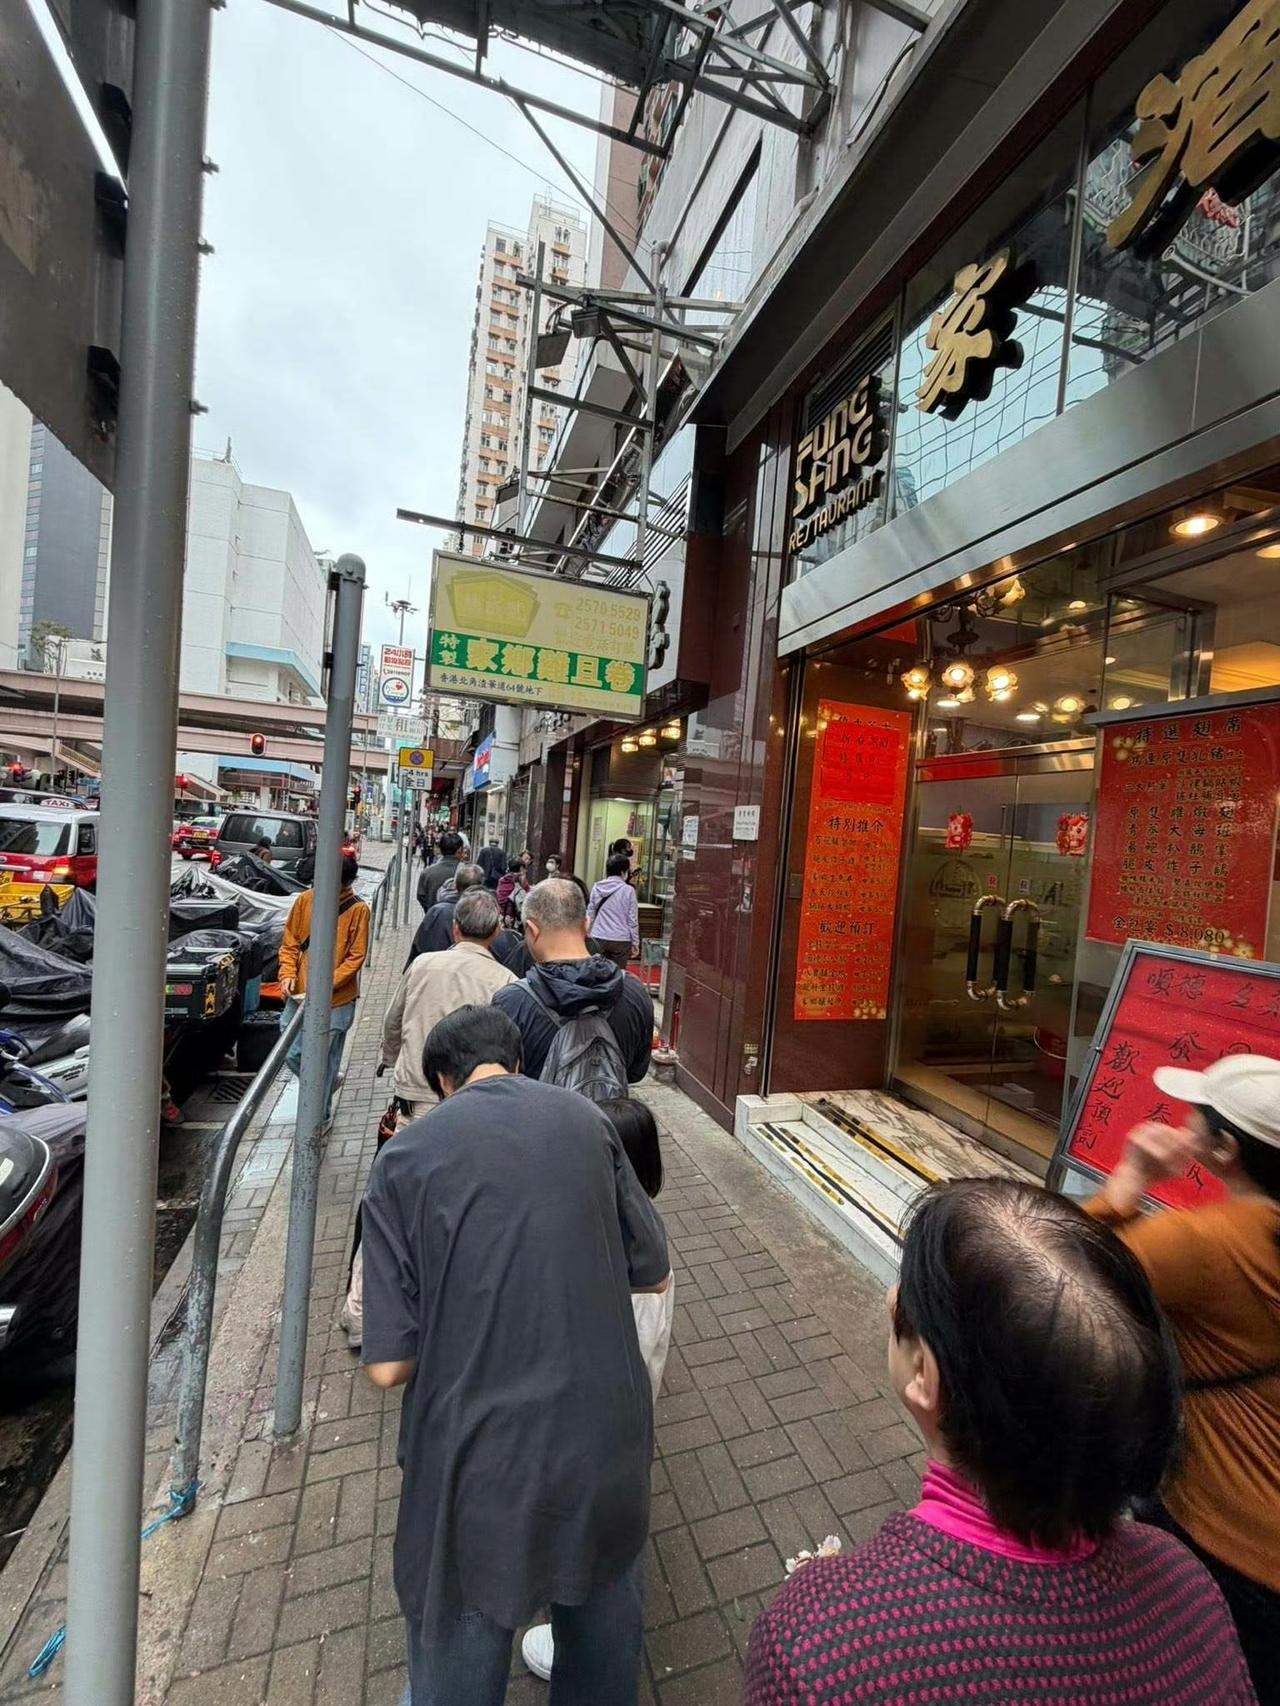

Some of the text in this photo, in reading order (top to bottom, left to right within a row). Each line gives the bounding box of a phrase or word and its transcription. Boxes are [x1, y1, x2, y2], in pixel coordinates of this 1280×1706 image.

[797, 374, 870, 479] FUNG
[792, 413, 873, 518] SHING
[788, 471, 875, 552] RESTAURANT
[575, 599, 641, 622] 2570 5529
[575, 617, 640, 640] 2571 5049
[1135, 716, 1243, 743] 特選翅席
[47, 799, 70, 807] TAXI
[828, 816, 884, 834] 特別推介
[820, 920, 874, 936] 歡迎預訂
